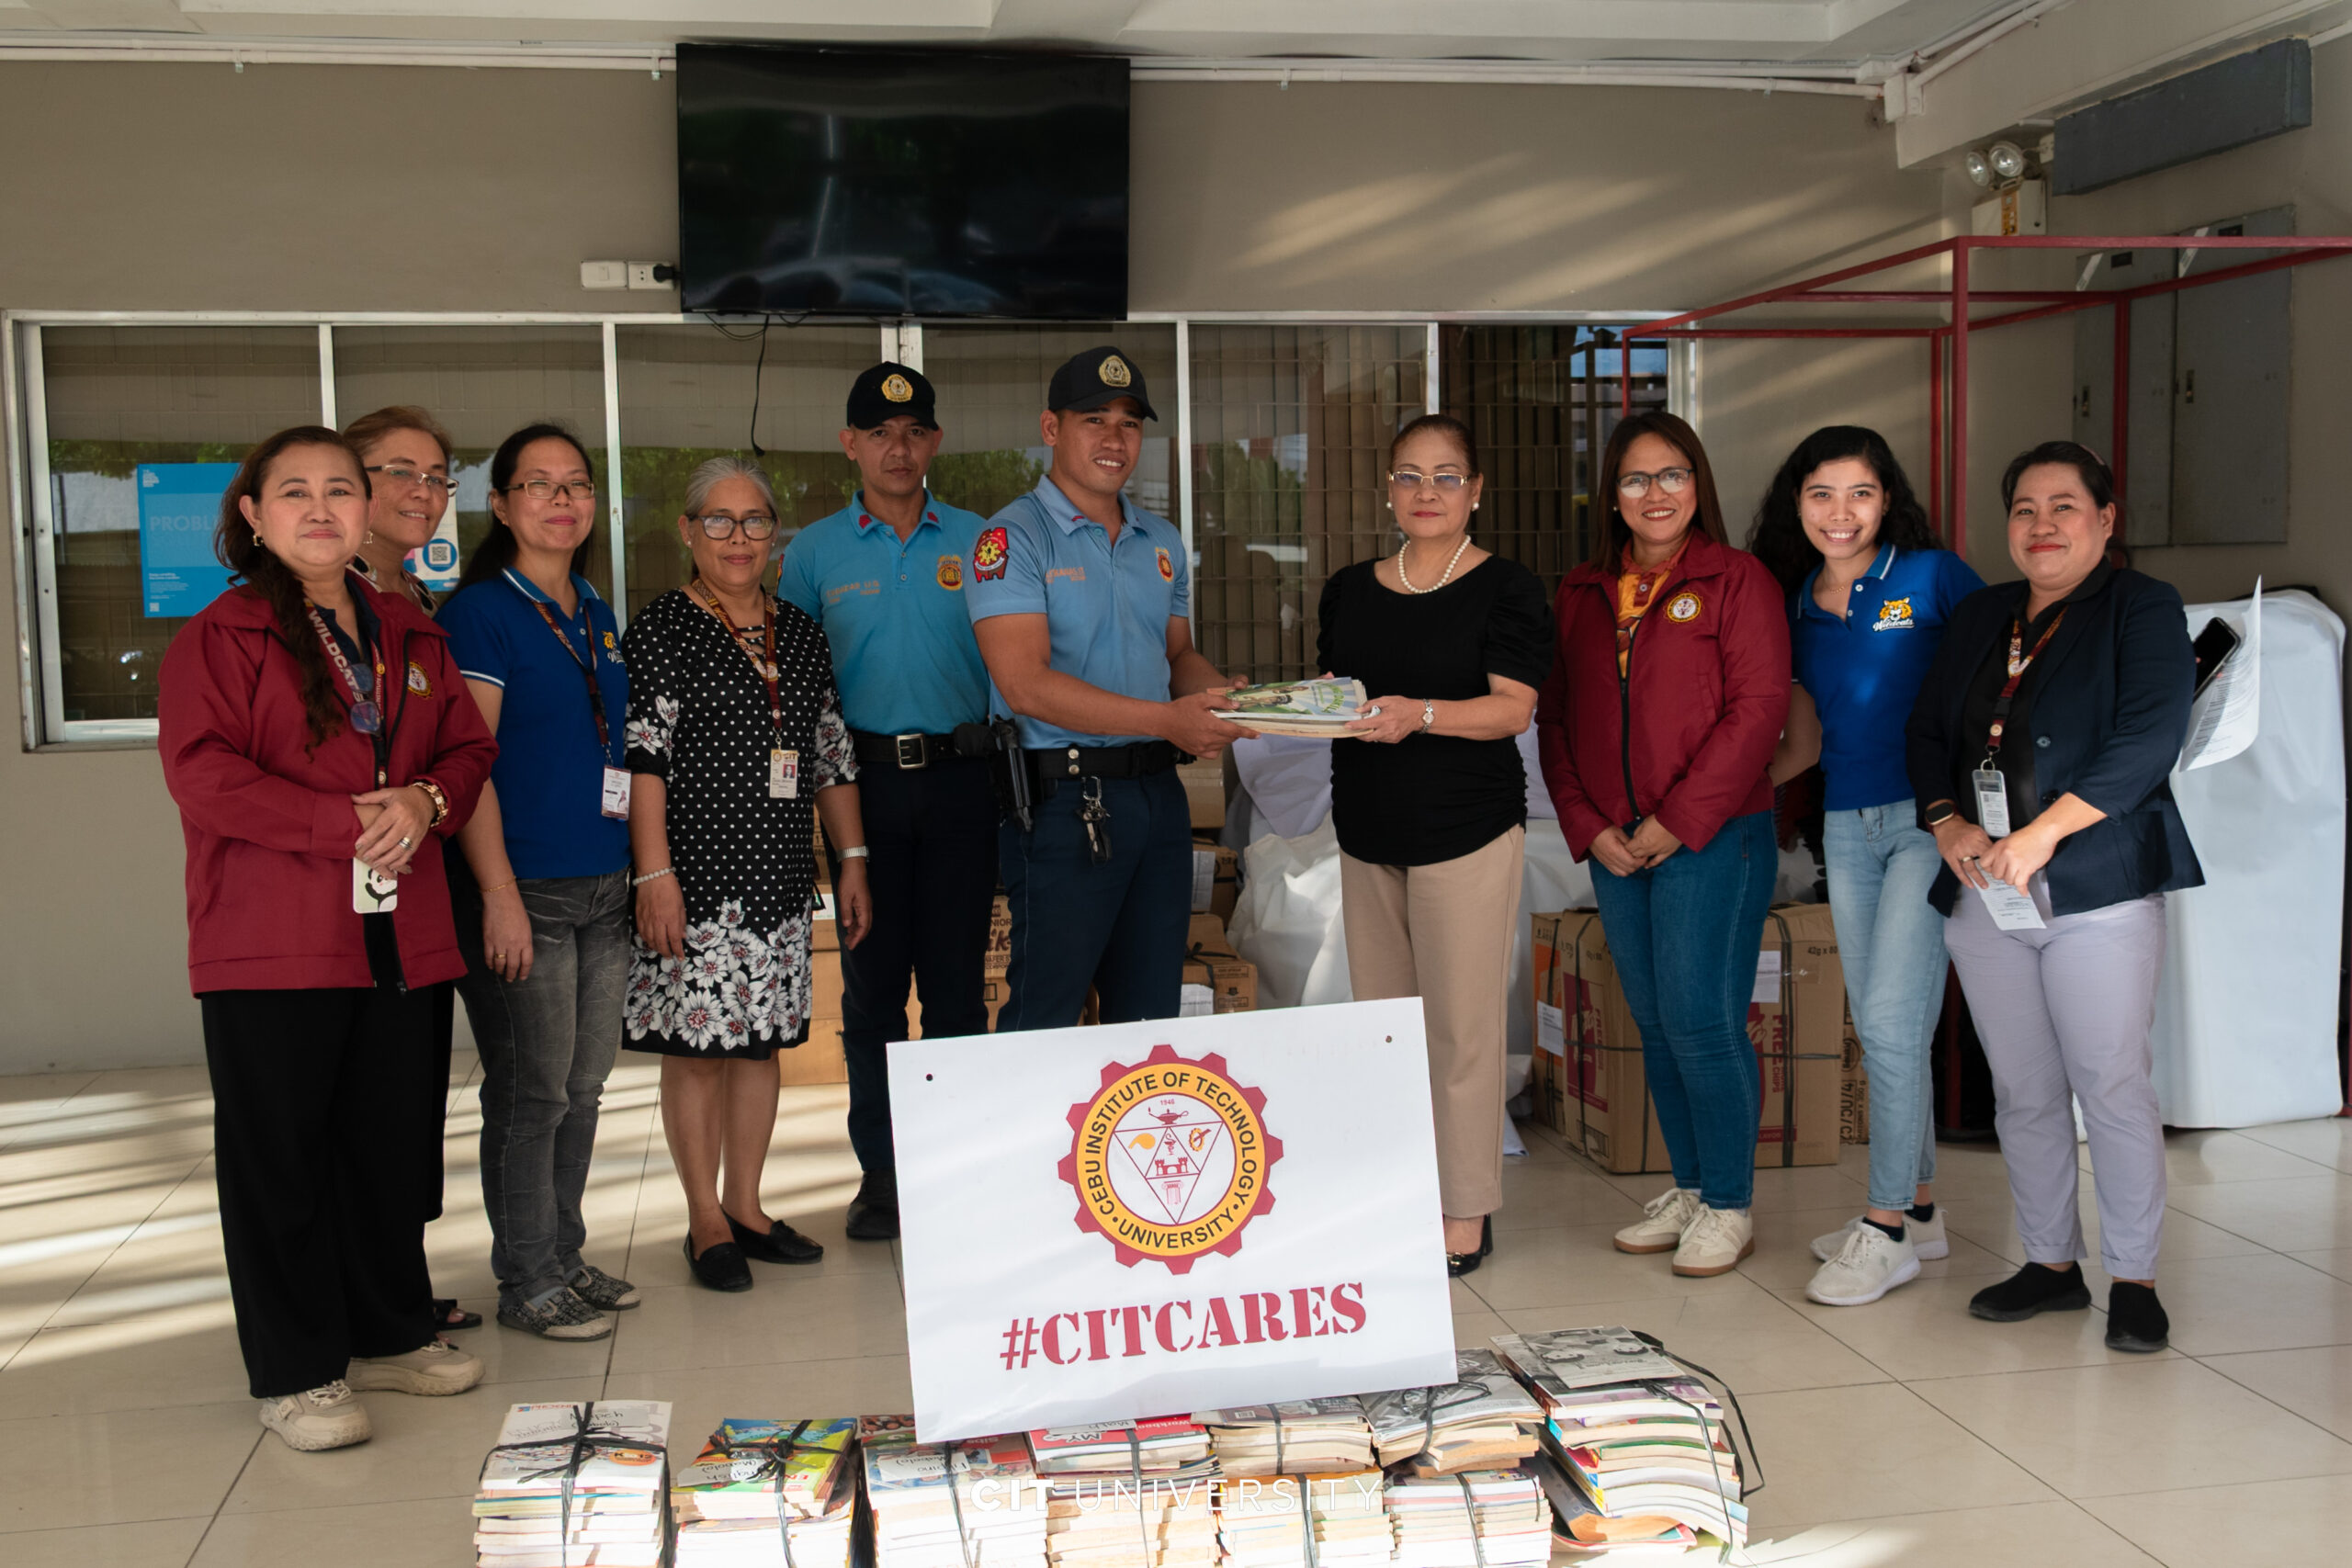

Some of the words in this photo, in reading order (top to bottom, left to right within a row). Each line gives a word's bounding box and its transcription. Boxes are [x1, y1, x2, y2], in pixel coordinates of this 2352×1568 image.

[1163, 1072, 1191, 1088] OF
[1086, 1074, 1159, 1155] INSTITUTE
[1195, 1076, 1257, 1206] TECHNOLOGY
[1085, 1159, 1115, 1214] CEBU
[1118, 1207, 1234, 1248] UNIVERSITY
[999, 1282, 1367, 1371] #CITCARES
[706, 1470, 757, 1483] nglish
[917, 1462, 967, 1474] Filpino
